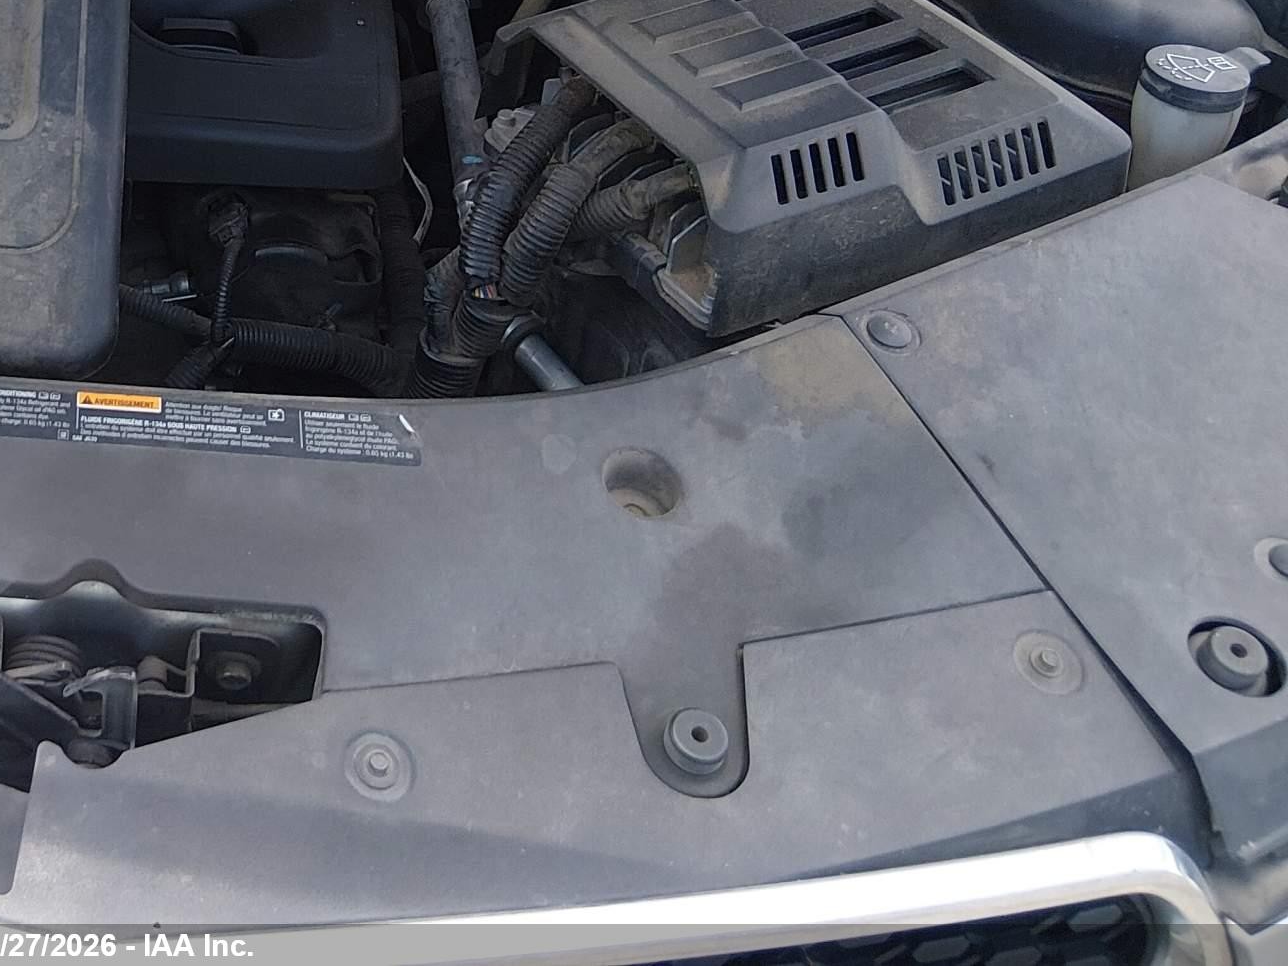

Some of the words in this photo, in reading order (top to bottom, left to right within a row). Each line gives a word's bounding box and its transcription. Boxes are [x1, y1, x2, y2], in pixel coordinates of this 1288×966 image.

[94, 397, 154, 408] AVERTISSEMENT
[304, 411, 345, 420] CLIMATISEUR
[144, 419, 166, 427] R-134a
[185, 423, 205, 431] HAUTE
[206, 424, 237, 432] PRESSION
